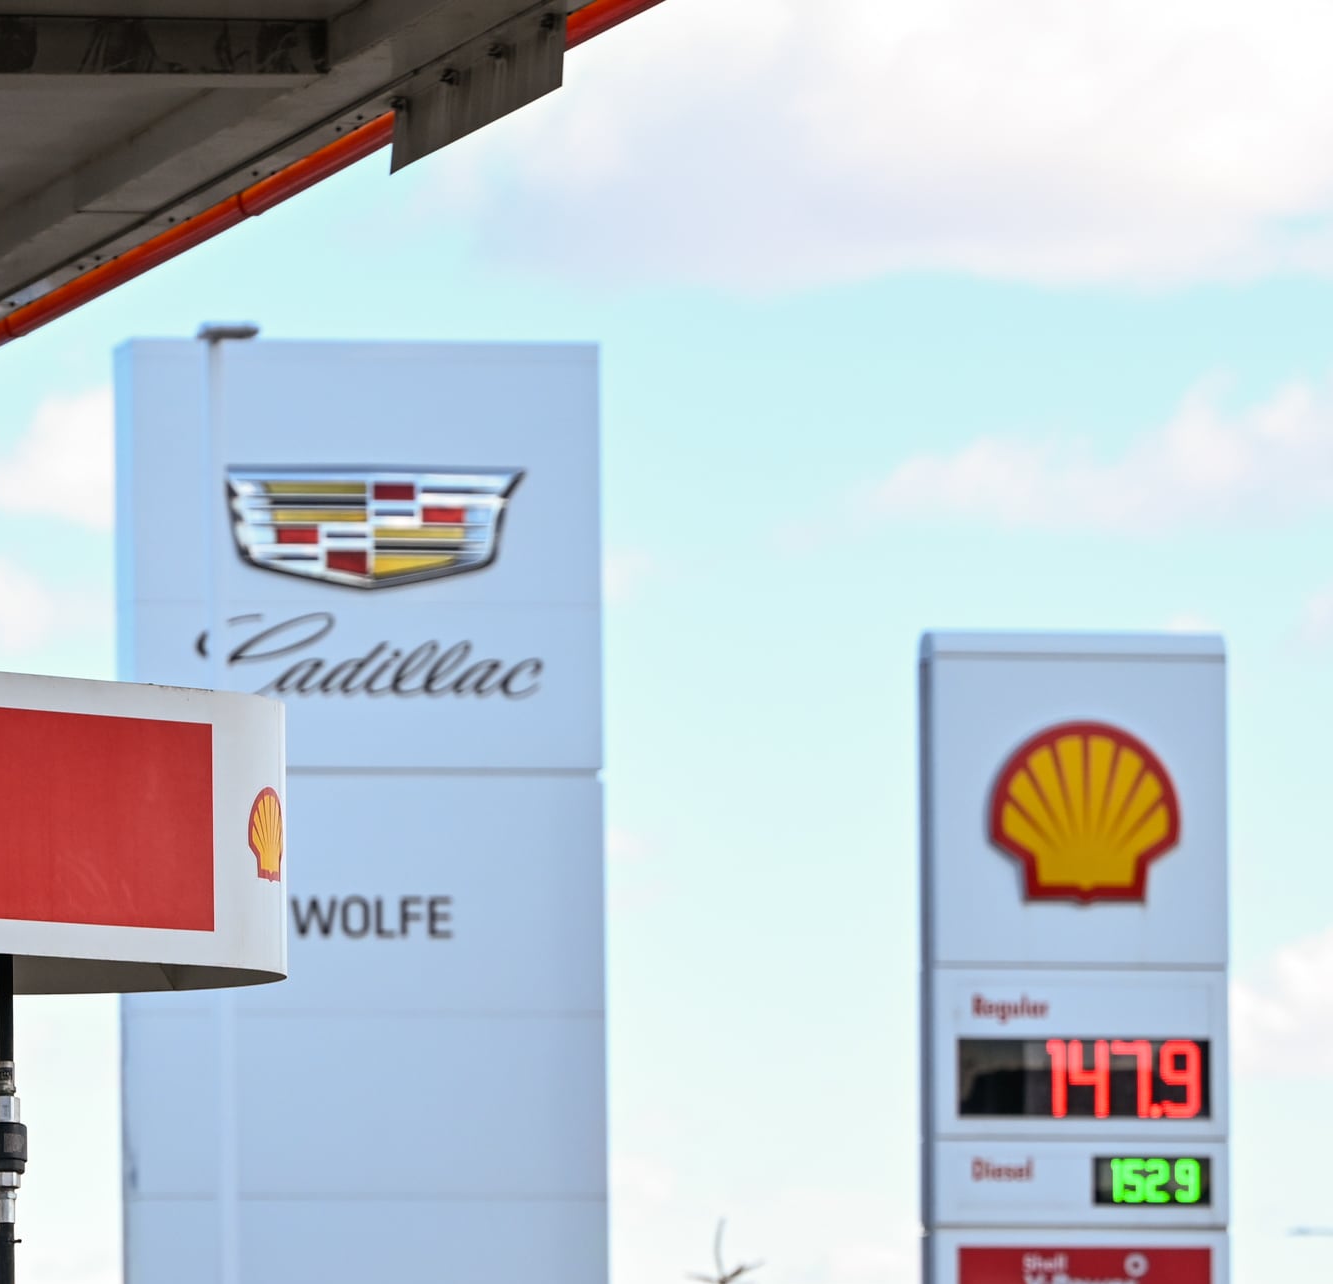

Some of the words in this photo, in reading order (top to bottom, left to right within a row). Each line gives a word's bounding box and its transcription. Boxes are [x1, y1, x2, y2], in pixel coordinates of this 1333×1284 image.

[292, 896, 453, 940] WOLFE
[972, 995, 1048, 1023] Regular
[1046, 1039, 1201, 1119] 147.9
[972, 1157, 1034, 1182] Diesel
[1022, 1253, 1068, 1272] Shell
